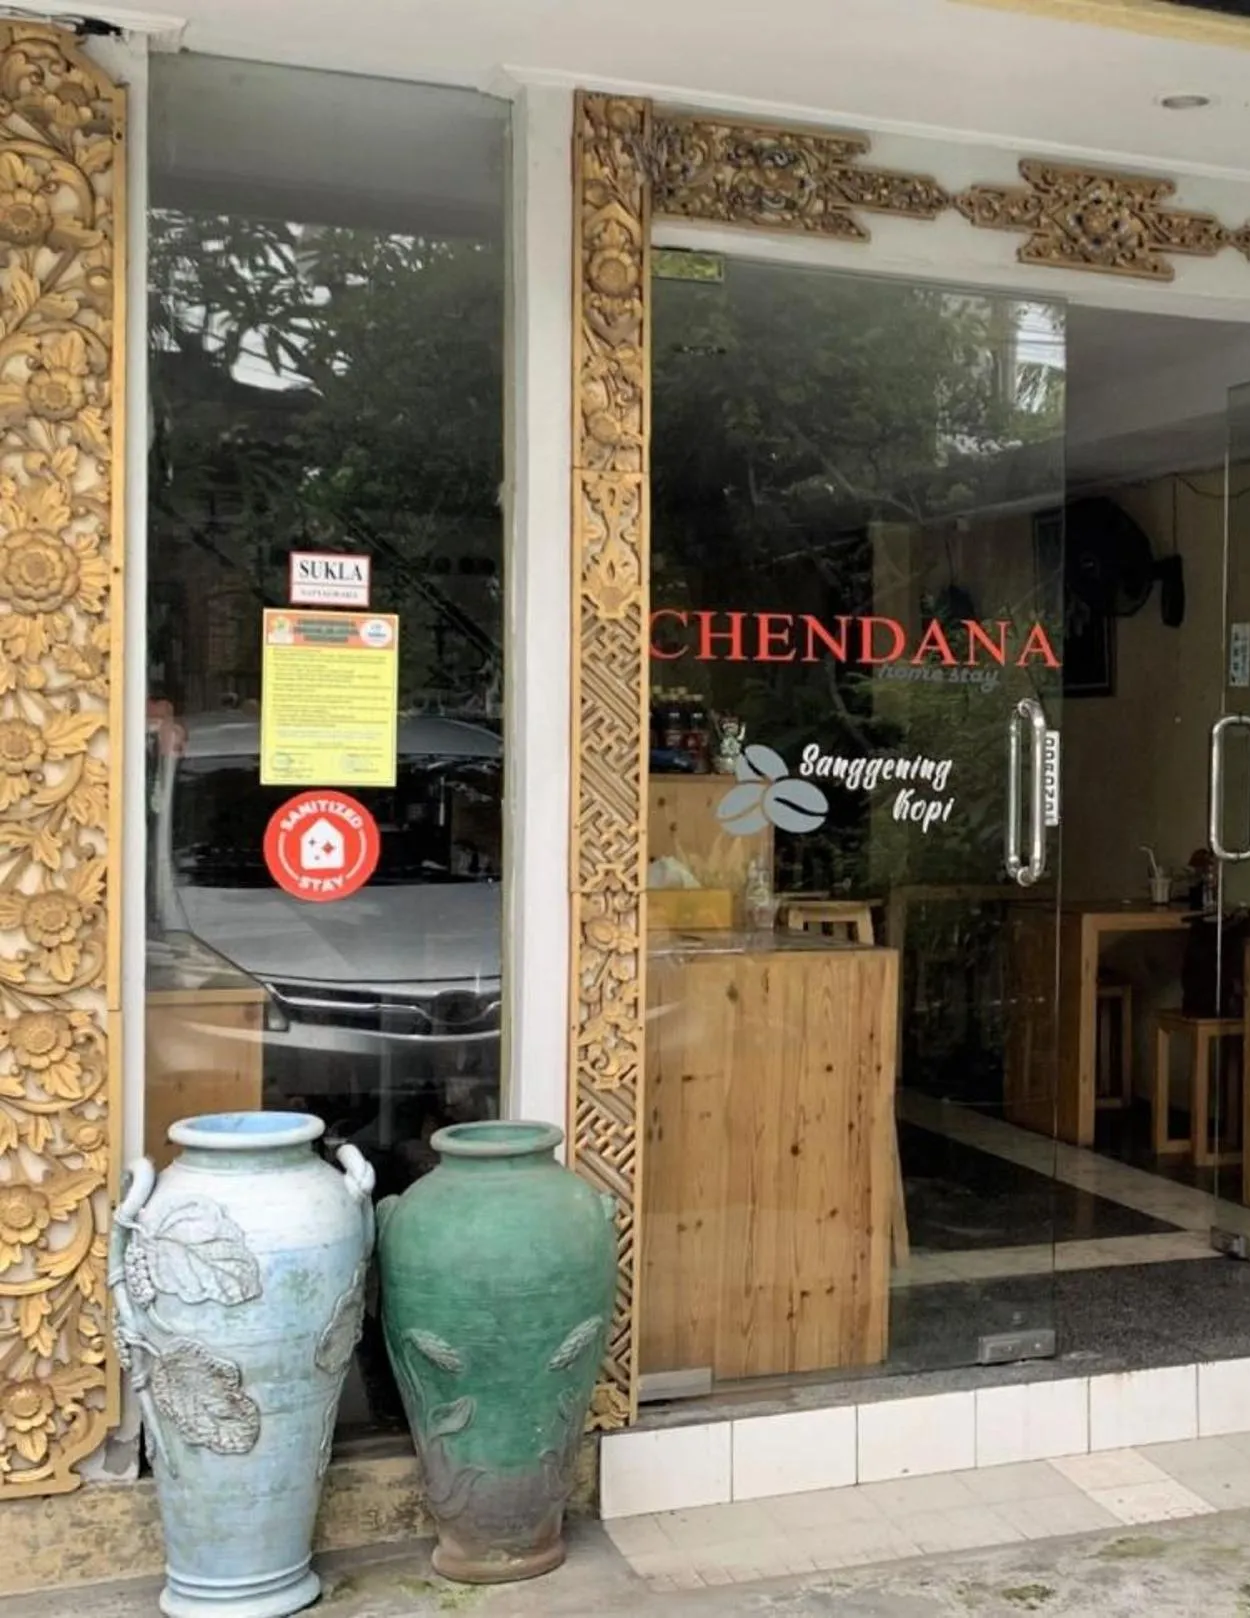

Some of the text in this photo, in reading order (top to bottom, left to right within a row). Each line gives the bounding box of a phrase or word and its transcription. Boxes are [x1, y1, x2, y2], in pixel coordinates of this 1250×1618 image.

[299, 559, 363, 582] SUKLA
[649, 609, 1061, 668] CHENDANA
[880, 662, 1000, 693] home stay
[800, 743, 953, 791] Sanggening
[280, 799, 363, 831] SANITIZED
[893, 788, 955, 834] Kopi
[297, 876, 347, 895] STAY
